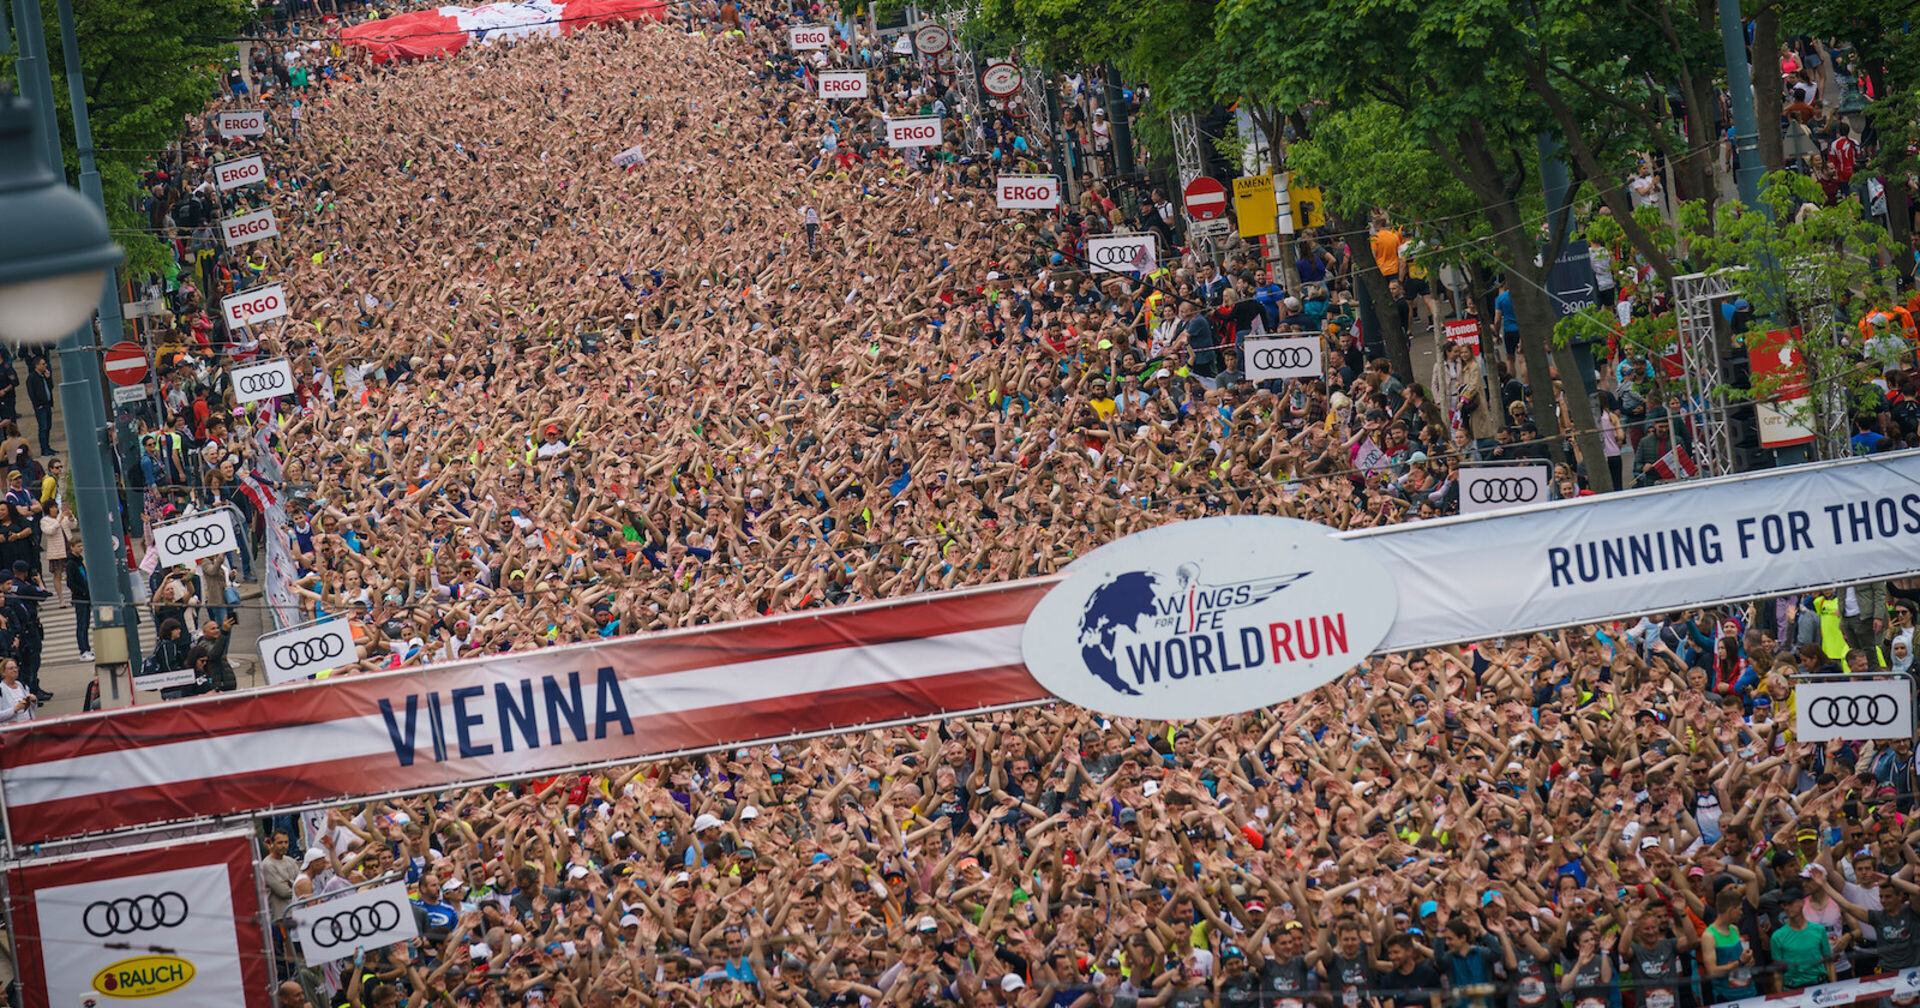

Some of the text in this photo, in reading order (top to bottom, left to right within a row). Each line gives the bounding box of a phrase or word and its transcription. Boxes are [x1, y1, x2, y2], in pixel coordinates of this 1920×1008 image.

[794, 32, 826, 45] ERGO
[823, 79, 862, 92] ERGO
[224, 118, 258, 130] ERGO
[893, 125, 936, 141] ERGO
[221, 163, 259, 183] ERGO
[1003, 185, 1050, 201] ERGO
[228, 215, 270, 239] ERGO
[231, 295, 279, 320] ERGO
[1445, 323, 1478, 337] Kronen
[1548, 493, 1920, 587] RUNNING FOR THOS
[1155, 609, 1227, 635] FOR LIFE
[378, 666, 635, 767] VIENNA
[119, 964, 182, 988] RAUCH
